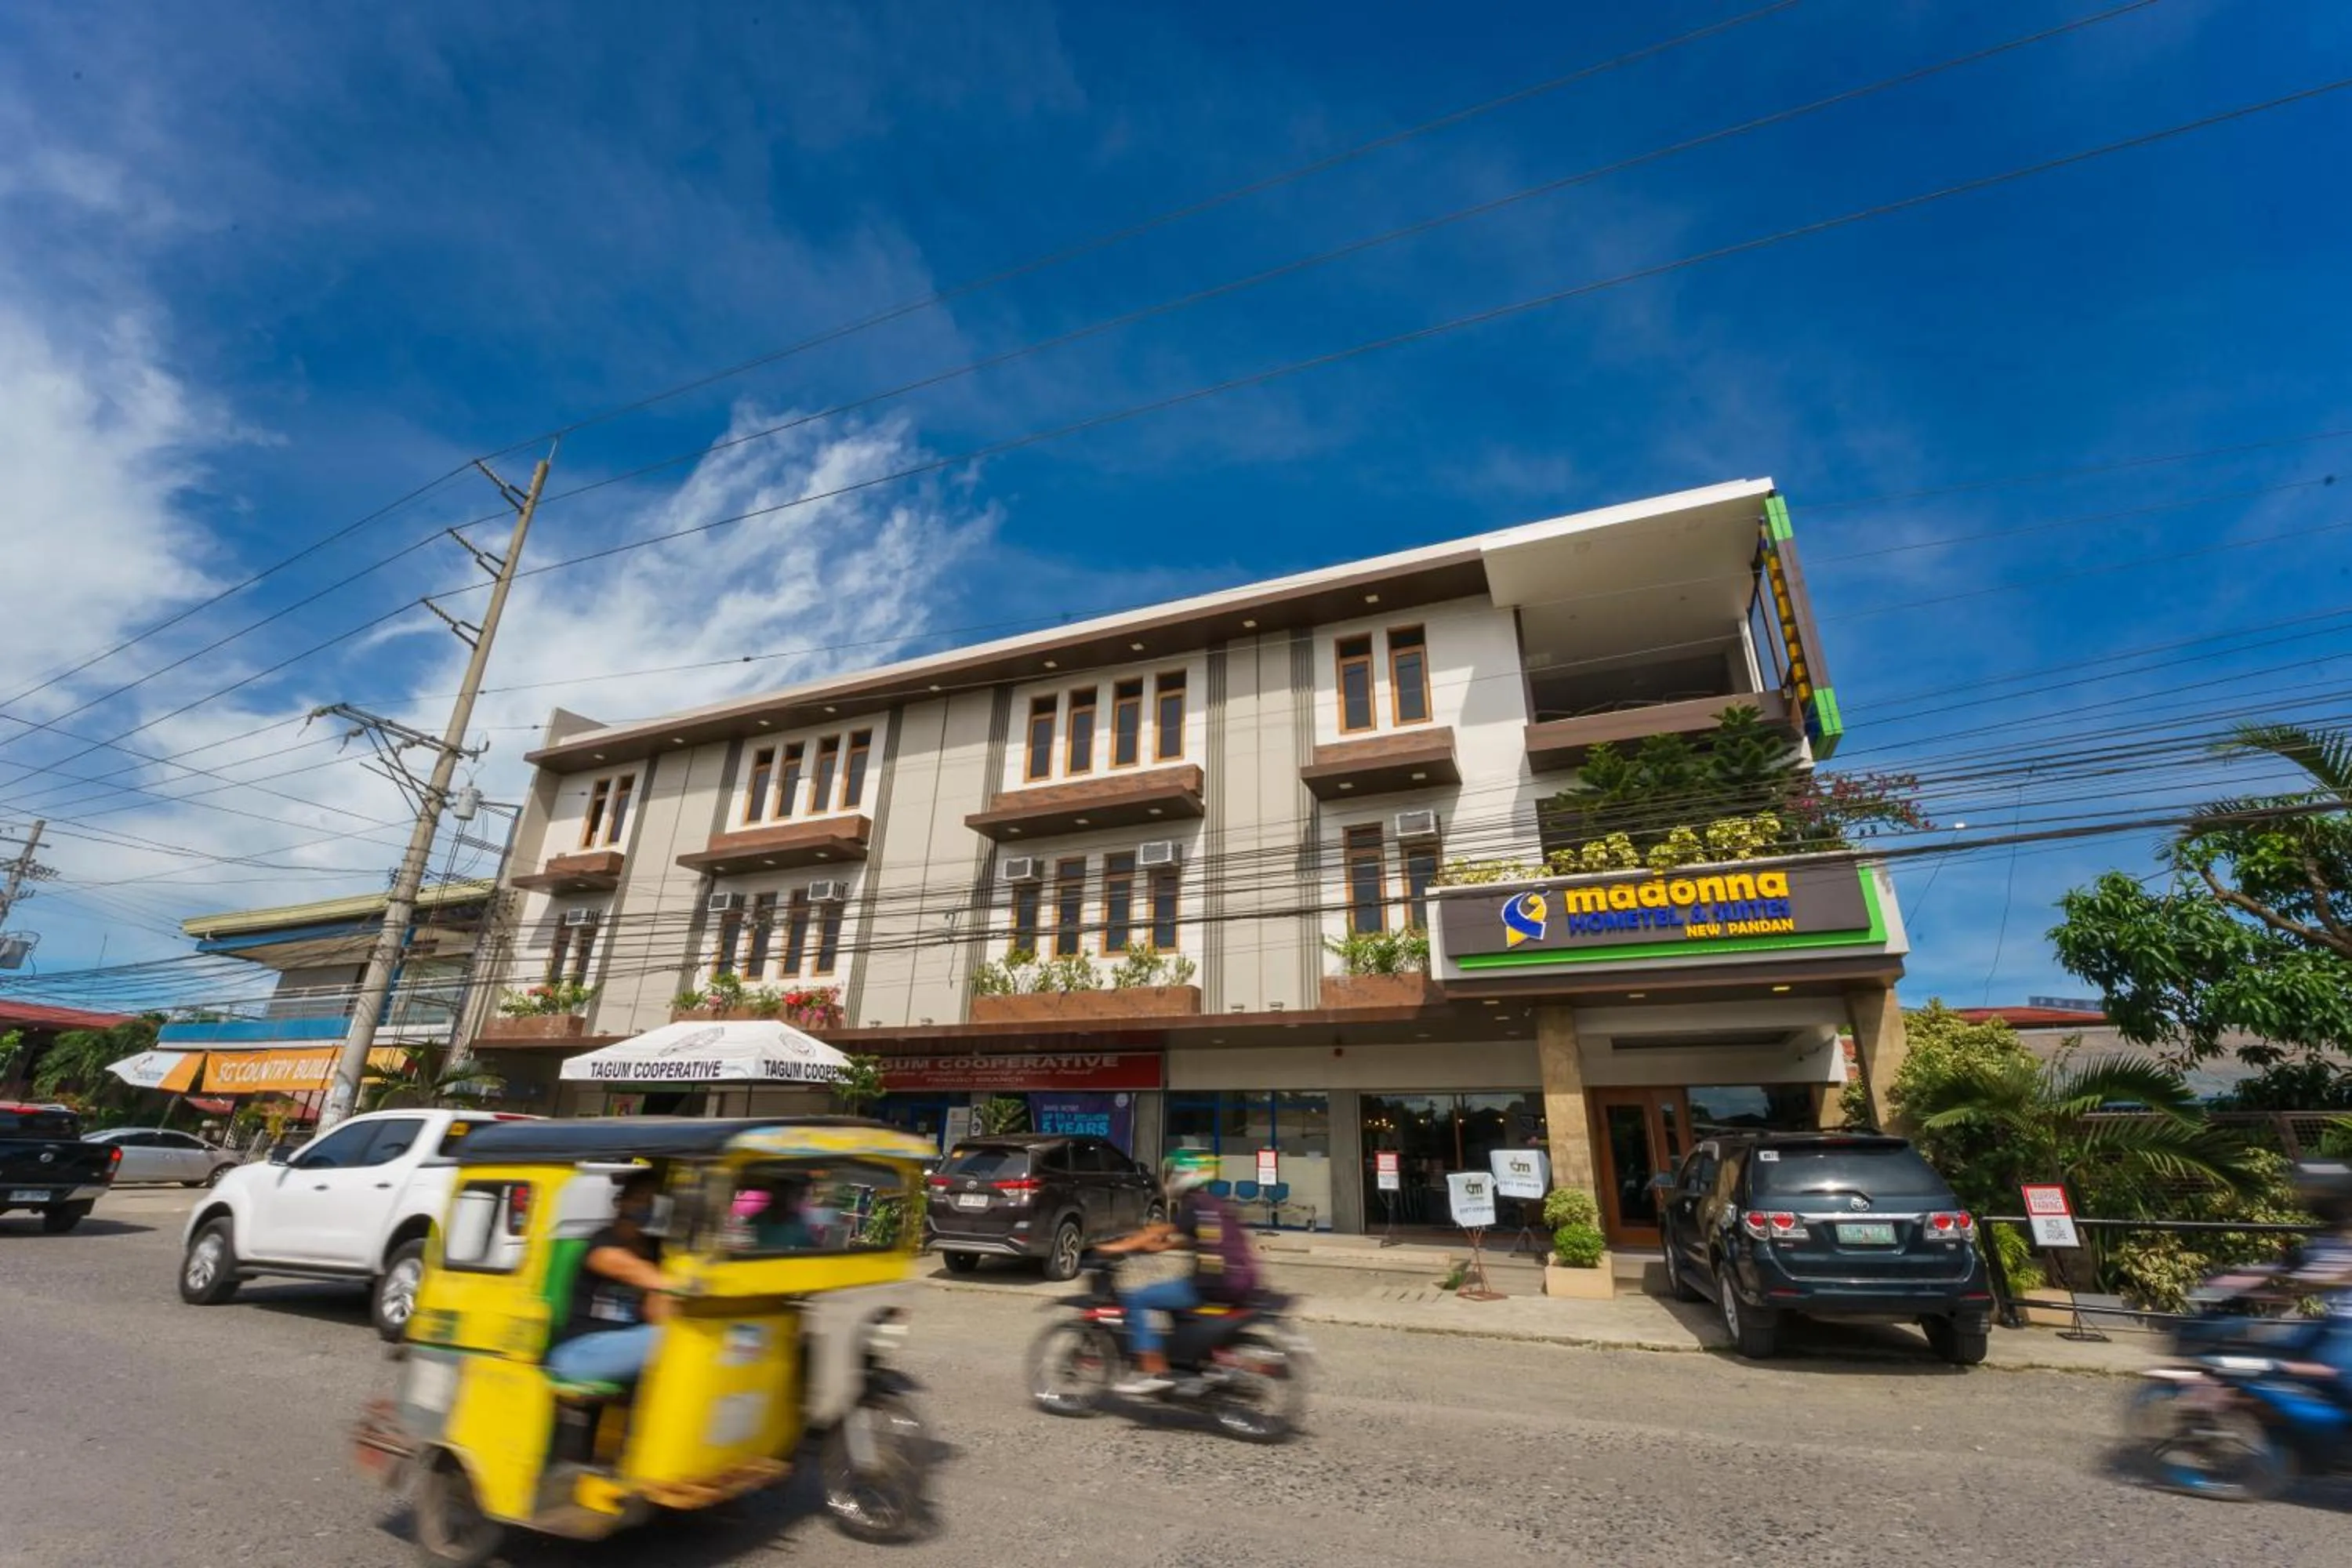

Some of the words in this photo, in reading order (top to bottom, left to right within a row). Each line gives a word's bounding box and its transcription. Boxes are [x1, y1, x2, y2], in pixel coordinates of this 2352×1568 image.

[1566, 869, 1789, 913] madonna
[1569, 906, 1683, 936] HOMETEL
[1690, 903, 1707, 923] &
[1712, 899, 1792, 923] SUITES
[1686, 923, 1720, 938] NEW
[1728, 917, 1794, 935] PANDAN
[236, 1059, 292, 1082] COUNTRY
[590, 1062, 631, 1079] TAGUM
[633, 1060, 722, 1079] COOPERATIVE
[764, 1060, 802, 1080] TAGUM
[874, 1059, 930, 1071] GUM
[938, 1054, 1120, 1069] COOPERATIVE
[1042, 1122, 1051, 1134] 5
[1056, 1121, 1109, 1136] YEARS
